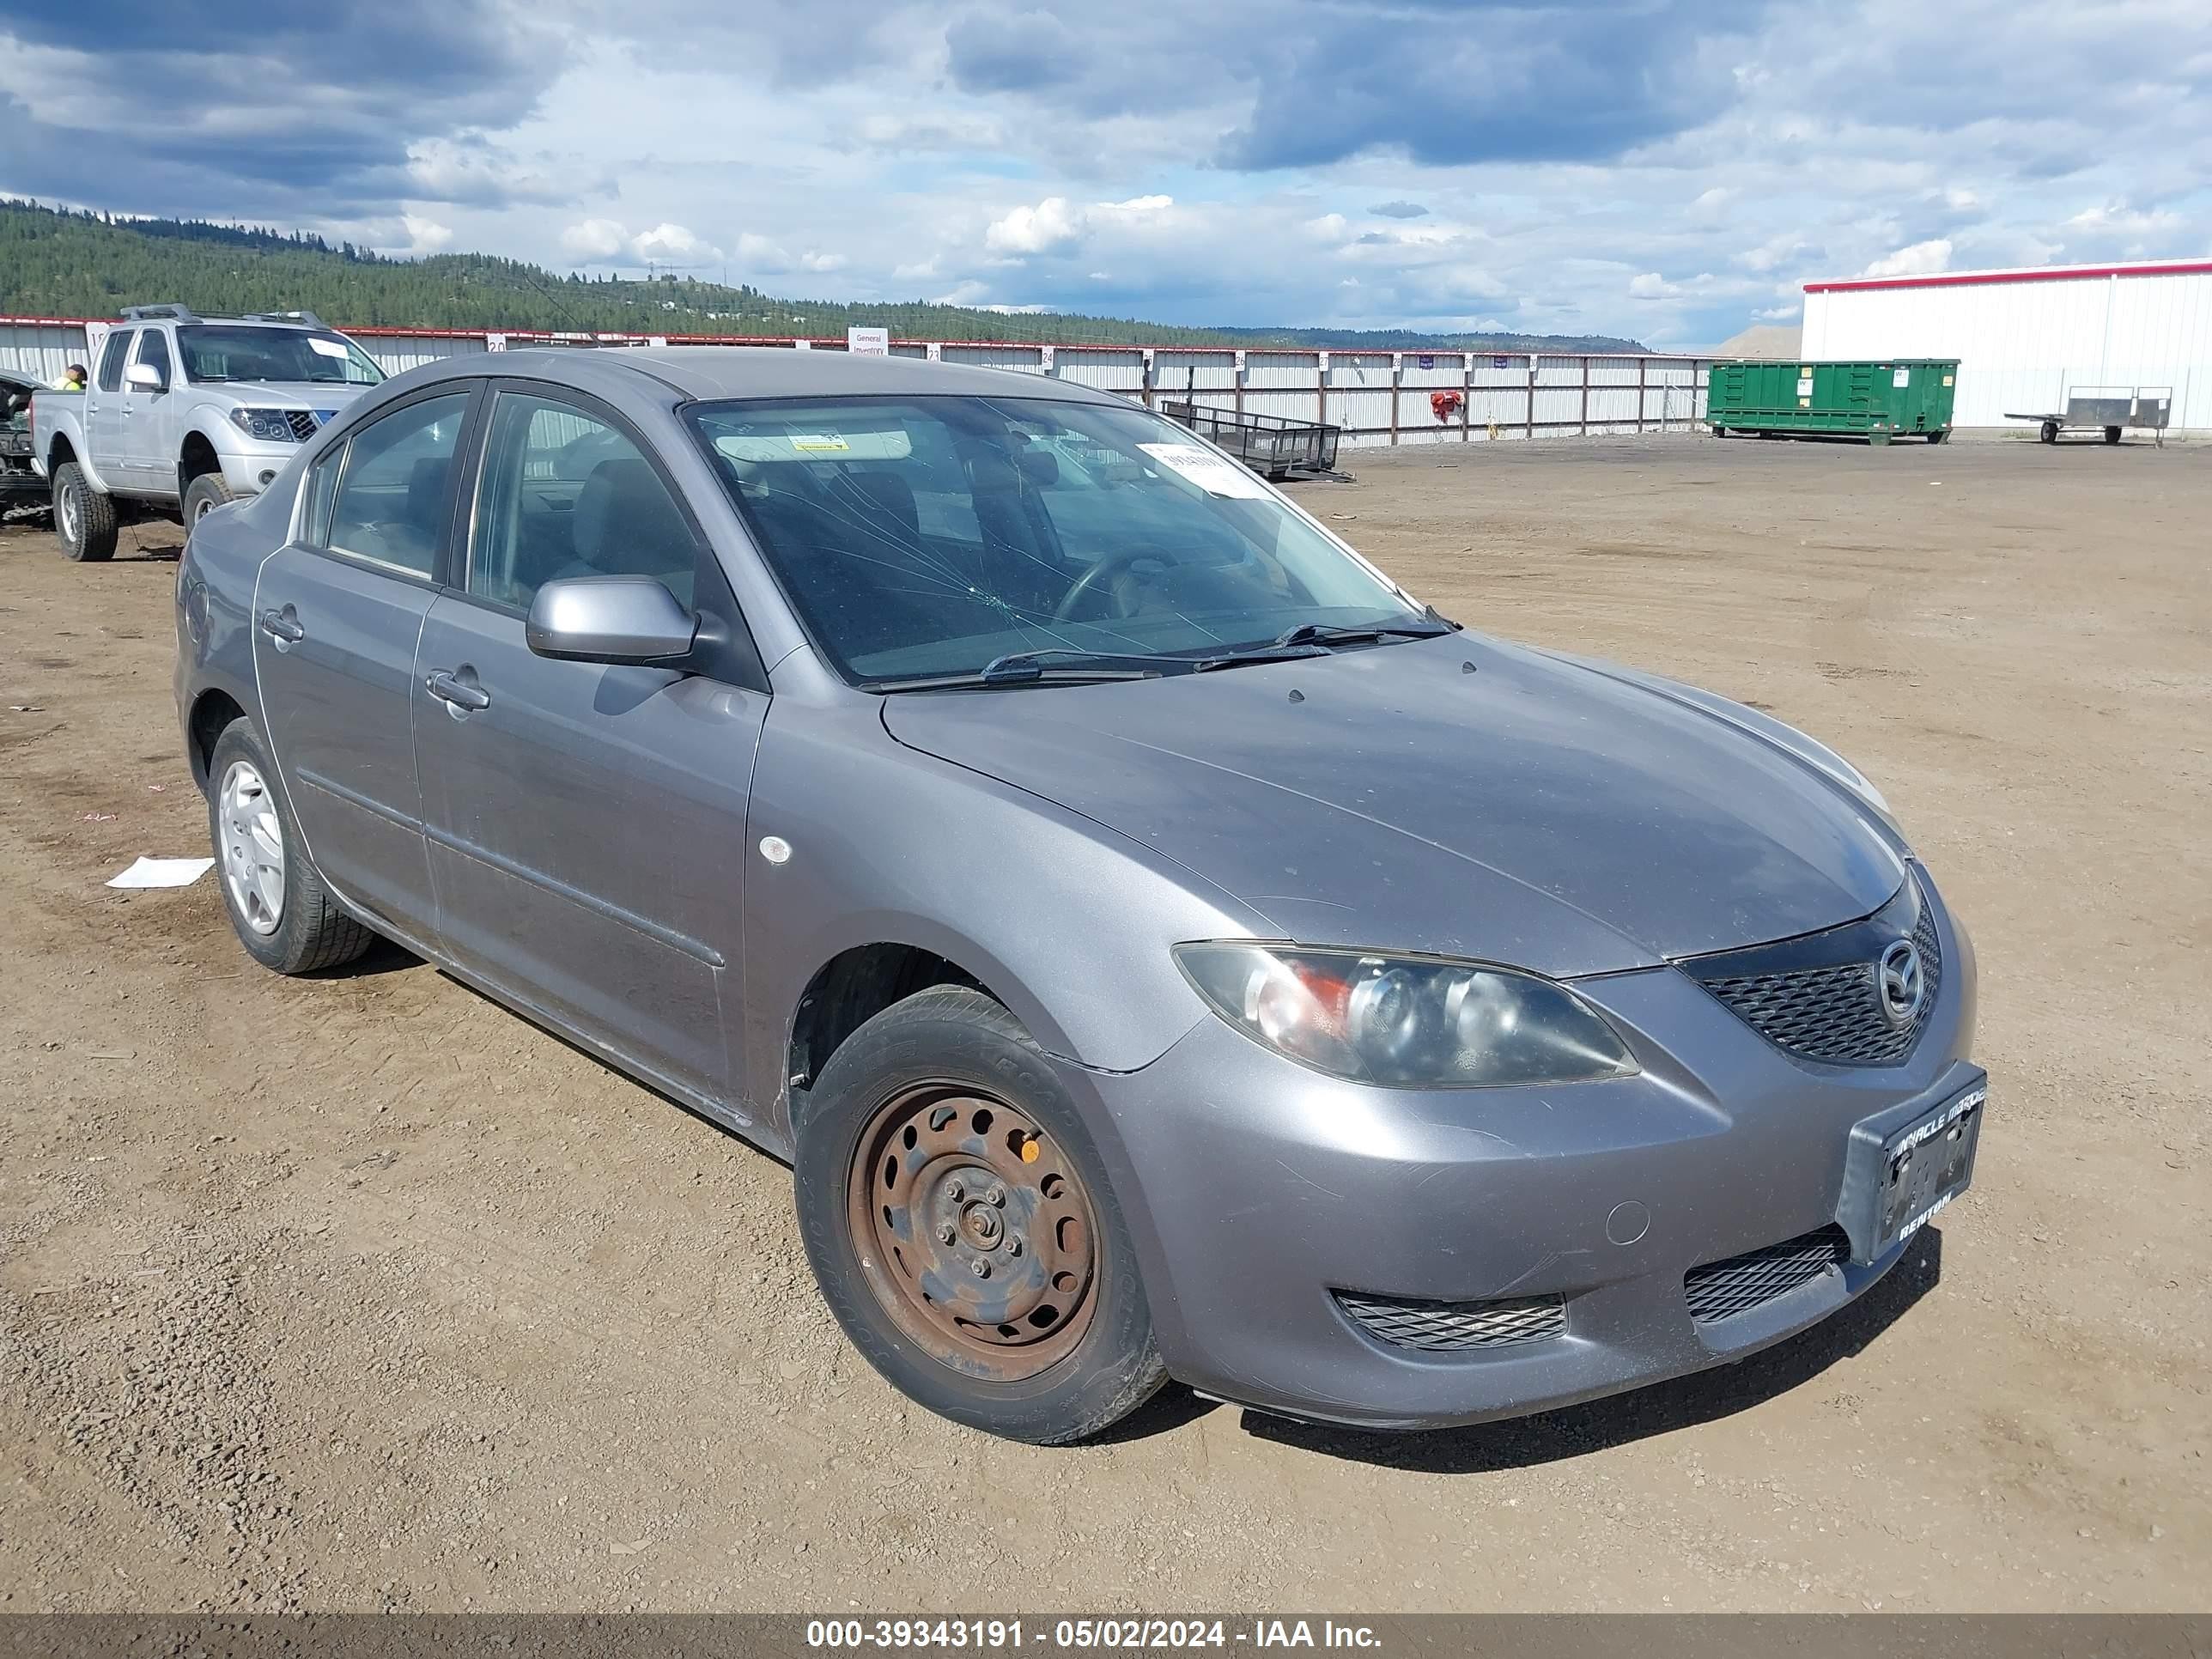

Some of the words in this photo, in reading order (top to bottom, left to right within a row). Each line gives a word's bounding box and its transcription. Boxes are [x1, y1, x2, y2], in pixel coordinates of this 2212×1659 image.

[857, 334, 881, 343] General
[489, 342, 505, 352] 20
[854, 346, 884, 356] Inventory
[928, 349, 939, 362] 23
[1042, 353, 1053, 363] 24
[1236, 356, 1245, 366] 26
[1320, 357, 1328, 366] 27
[1393, 358, 1401, 367] 28
[1465, 359, 1473, 368] 29
[1890, 1113, 1946, 1162] PINNACLE
[1899, 1190, 1952, 1242] RENTON
